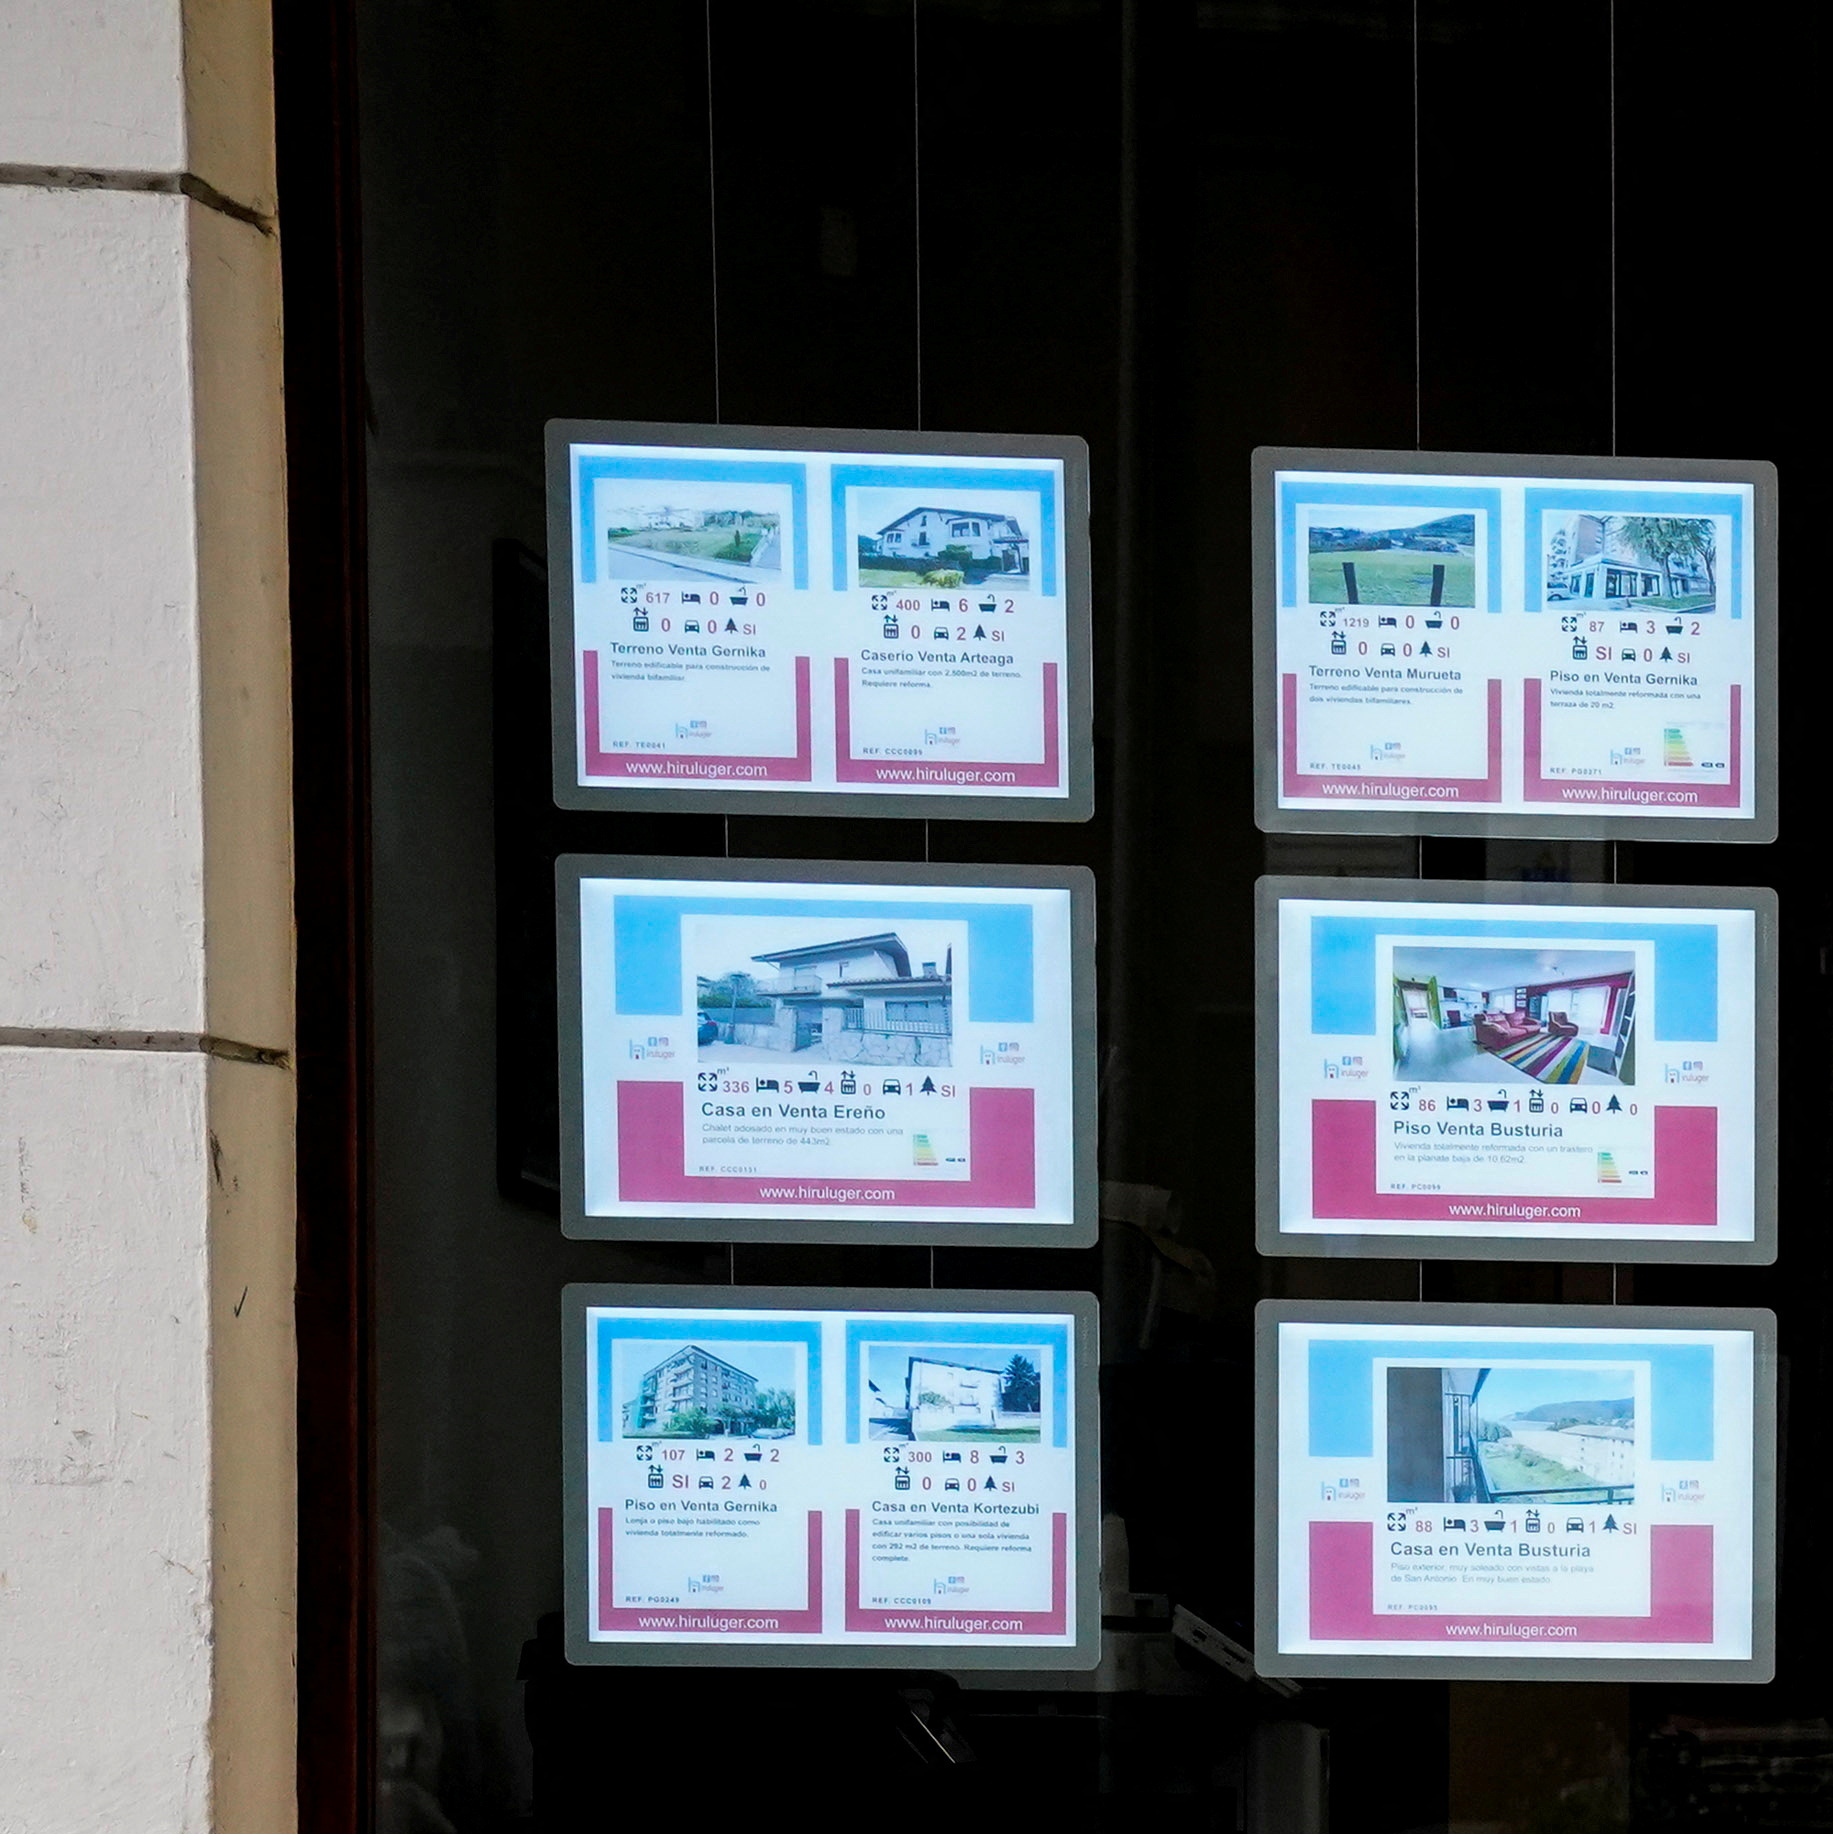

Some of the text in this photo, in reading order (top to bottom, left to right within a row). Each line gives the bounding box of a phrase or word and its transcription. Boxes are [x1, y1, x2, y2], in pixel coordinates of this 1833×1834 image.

[646, 591, 765, 606] 617 0 0
[896, 599, 1014, 613] 400 6 2
[1344, 615, 1459, 630] 1219 0 0
[1589, 620, 1700, 635] 87 3 2
[611, 642, 765, 657] Terreno Venta Gernika
[918, 651, 956, 662] Venta
[961, 652, 1013, 667] Arteaga
[1309, 665, 1461, 680] Terreno Venta Murueta
[1551, 671, 1697, 685] Piso en Venta Gernika
[624, 763, 767, 780] www.hiruluger.com
[874, 768, 1015, 784] www.hiruluger.com
[1320, 783, 1458, 800] www.hiruluger.com
[1560, 788, 1697, 806] www.hiruluger.com
[723, 1081, 955, 1097] 336 5 4 0 1 SI
[702, 1103, 885, 1119] Casa en Venta Ereño
[1394, 1121, 1562, 1137] Piso Venta Busturia
[760, 1187, 894, 1202] www.hiruluger.com
[1449, 1204, 1580, 1219] www.hiruluger.com
[626, 1499, 777, 1512] Piso en Venta Gernika
[872, 1501, 1039, 1514] Casa en Venta Kortezubi
[1391, 1542, 1590, 1557] Casa en Venta Busturia
[637, 1616, 778, 1632] www.hiruluger.com
[883, 1617, 1022, 1634] www.hiruluger.com
[1446, 1624, 1576, 1638] www.hiruluger.com
